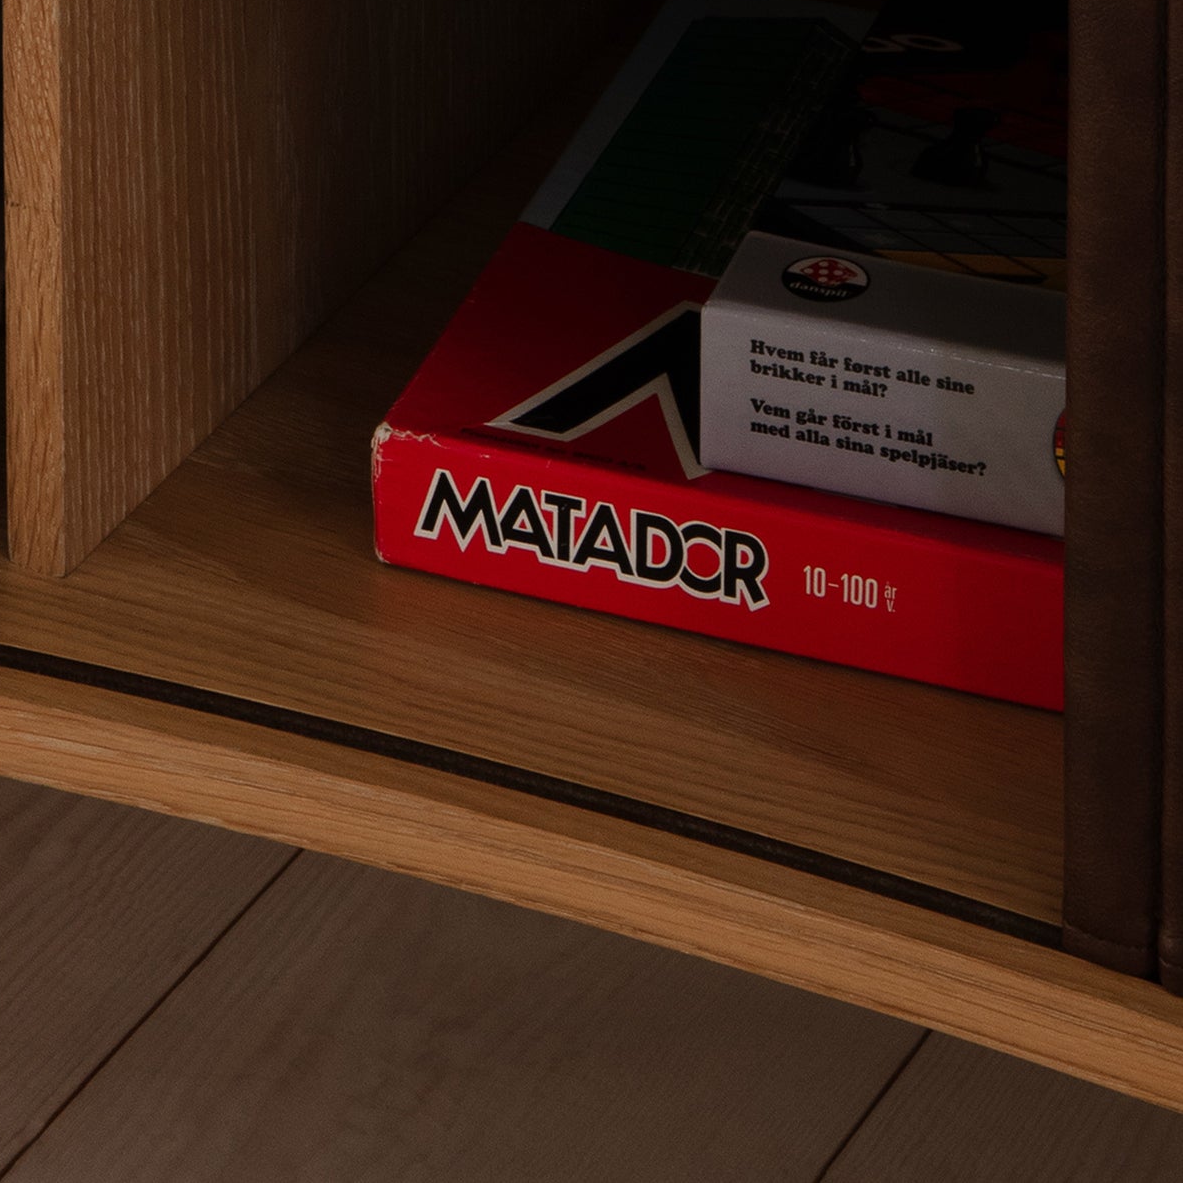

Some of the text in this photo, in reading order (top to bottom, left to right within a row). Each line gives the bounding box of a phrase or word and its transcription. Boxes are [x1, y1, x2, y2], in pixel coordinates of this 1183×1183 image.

[750, 339, 975, 395] Hvem får først alle sine
[750, 359, 888, 398] brikker i mål?
[750, 398, 933, 447] Vem går först i mål
[750, 421, 987, 476] med alla sina spelpjäser?
[413, 468, 771, 612] MATADOR
[802, 564, 879, 609] 10-100
